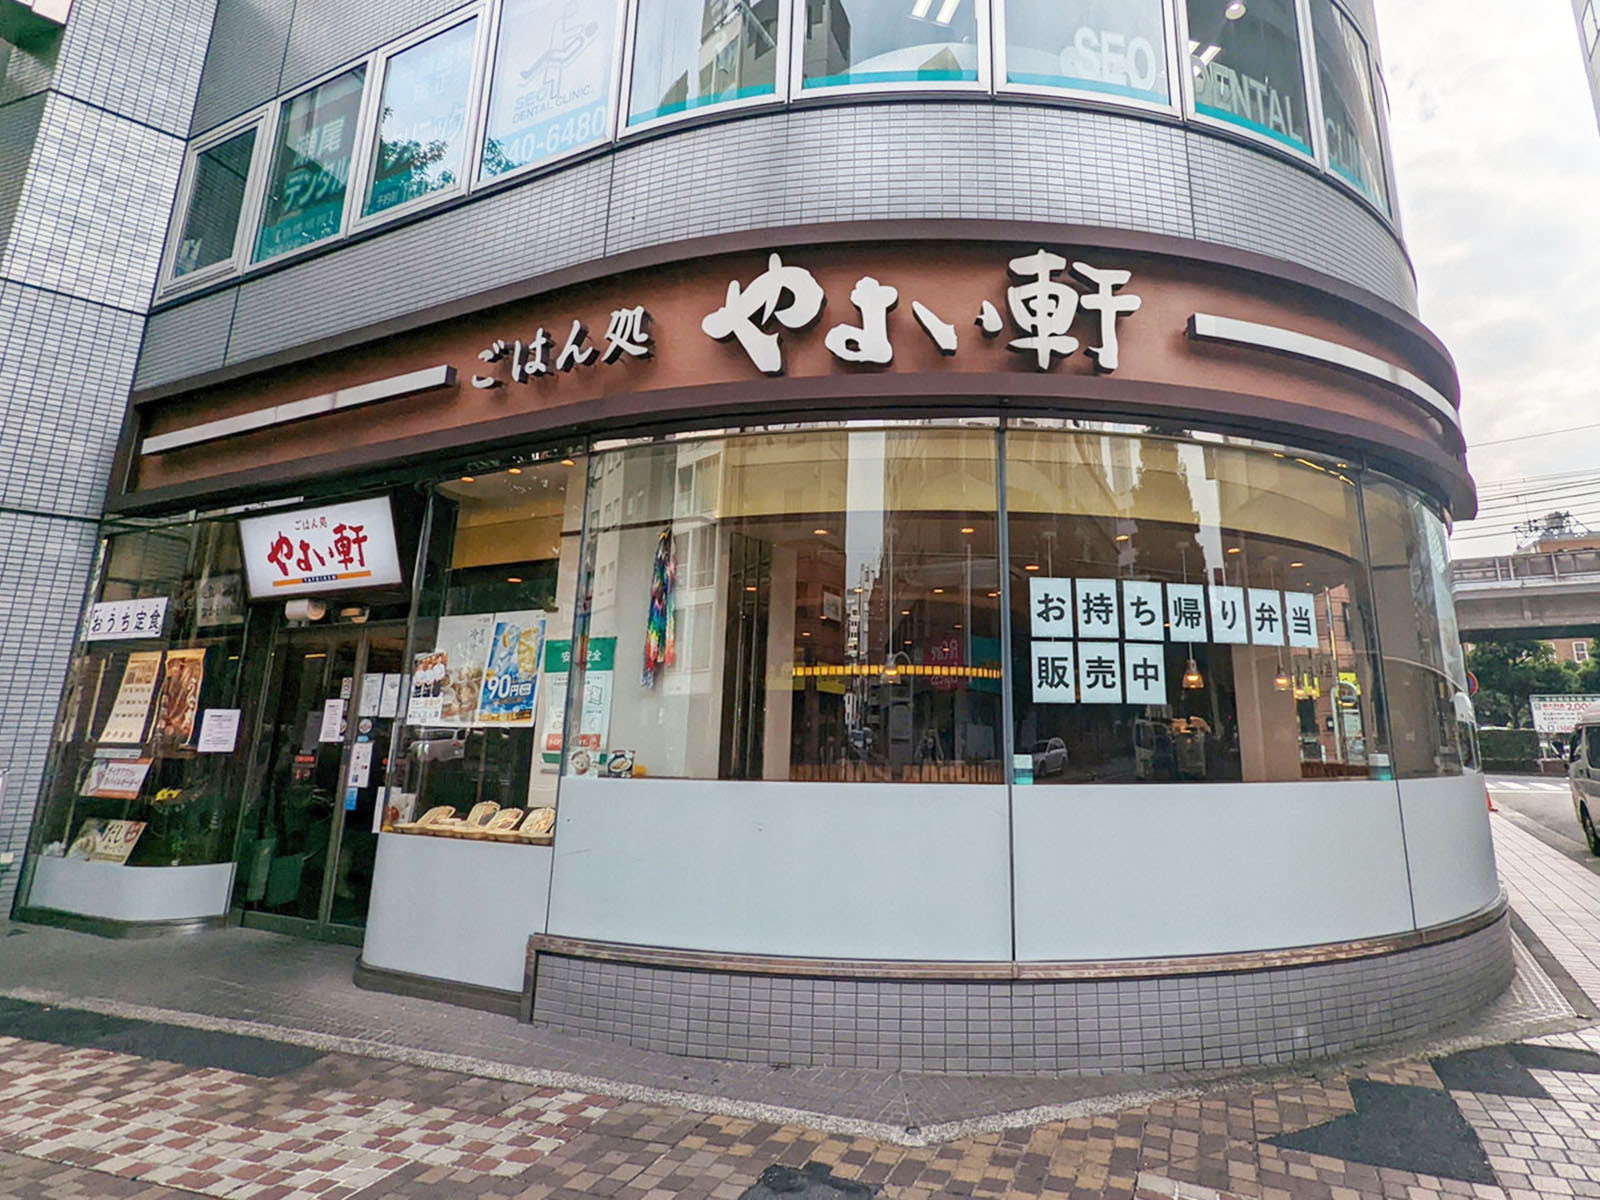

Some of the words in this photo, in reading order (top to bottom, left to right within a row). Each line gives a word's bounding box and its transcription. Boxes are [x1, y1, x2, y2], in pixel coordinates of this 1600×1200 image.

[1074, 27, 1156, 91] SEO
[472, 305, 649, 388] ごはん処
[702, 249, 1142, 372] やよい軒
[267, 523, 368, 577] やよい軒
[91, 609, 161, 632] おうち定食
[1036, 591, 1313, 637] お持ち帰り弁当
[1036, 655, 1161, 691] 販売中
